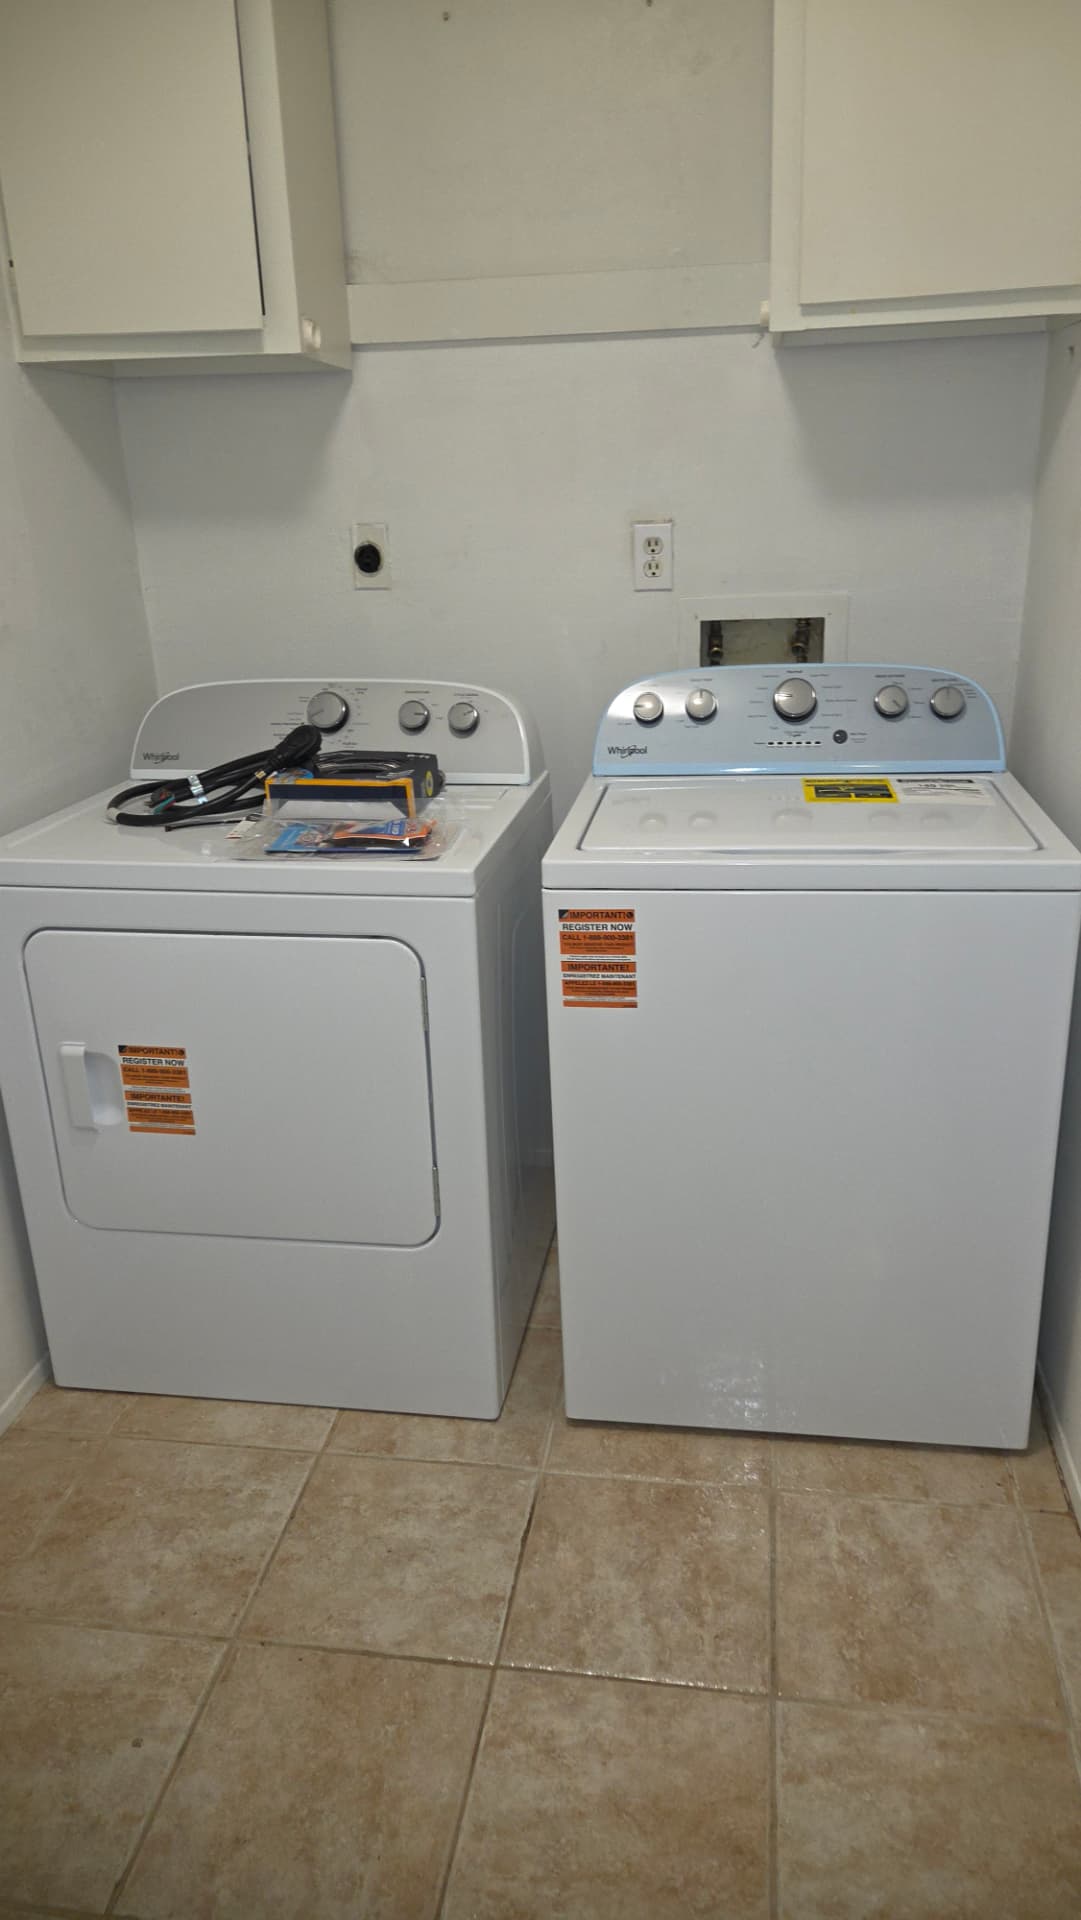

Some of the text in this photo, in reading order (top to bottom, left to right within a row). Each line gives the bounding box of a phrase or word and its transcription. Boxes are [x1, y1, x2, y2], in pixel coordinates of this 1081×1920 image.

[607, 744, 648, 759] Whirlpool
[142, 751, 180, 765] Whirlpool
[569, 911, 626, 919] IMPORTANT!
[562, 923, 633, 931] REGISTER NOW
[122, 1057, 163, 1065] REGISTER
